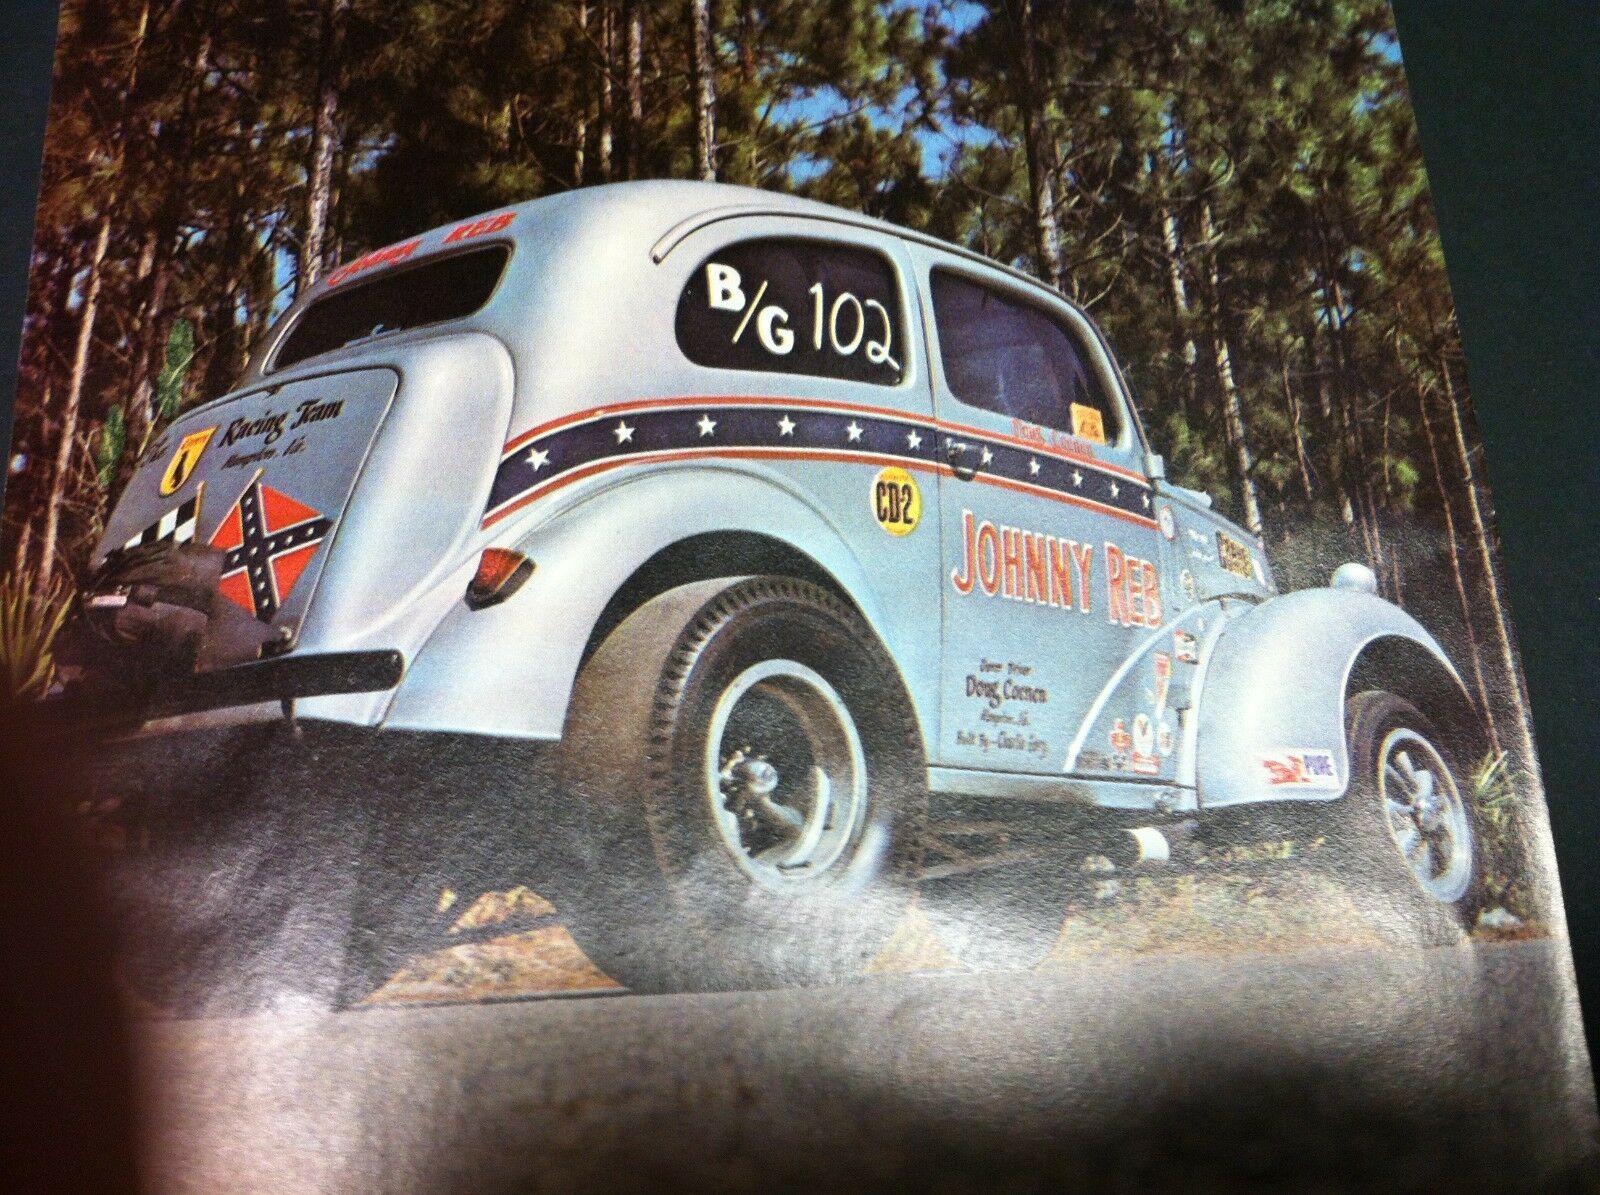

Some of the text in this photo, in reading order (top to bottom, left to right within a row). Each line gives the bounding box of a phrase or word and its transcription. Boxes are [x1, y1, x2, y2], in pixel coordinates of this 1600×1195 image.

[705, 262, 900, 371] B/G 102
[217, 398, 345, 448] Racing Team
[950, 508, 1094, 615] JOHNNY
[1104, 541, 1163, 629] REB
